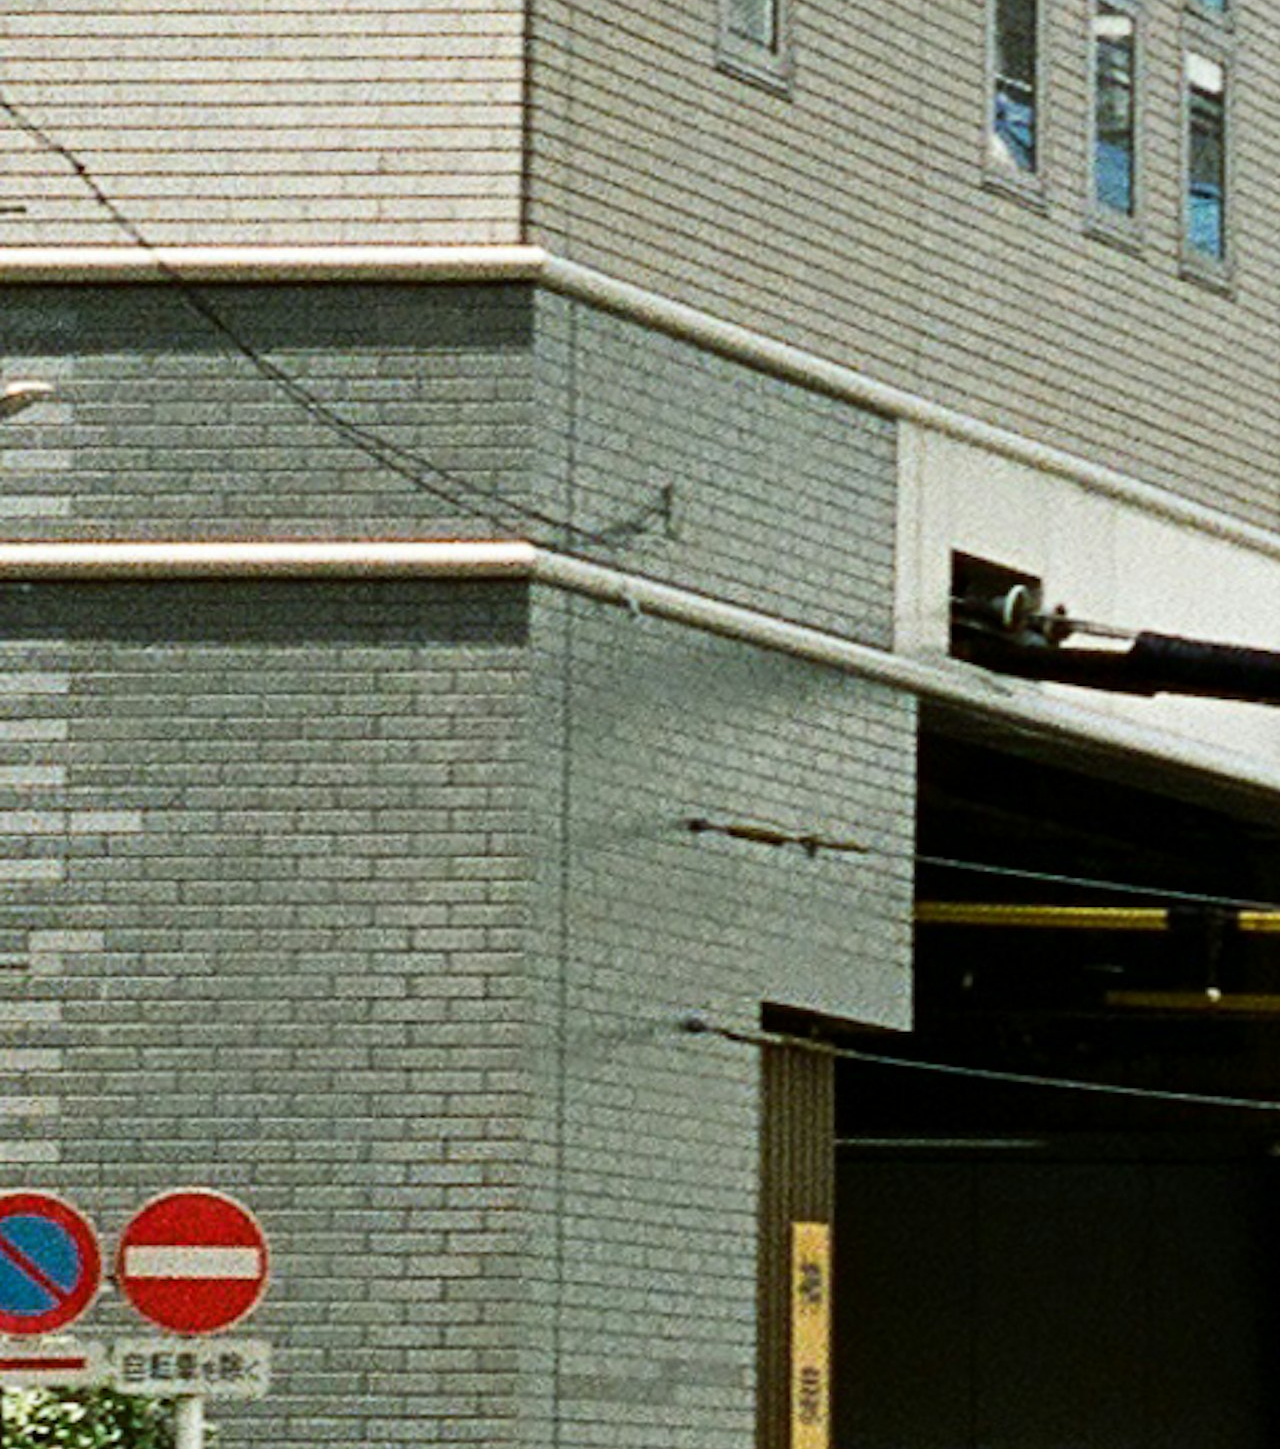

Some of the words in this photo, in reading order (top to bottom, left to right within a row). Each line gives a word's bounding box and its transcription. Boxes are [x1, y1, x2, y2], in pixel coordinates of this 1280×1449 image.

[122, 1352, 262, 1383] 自転車を除く
